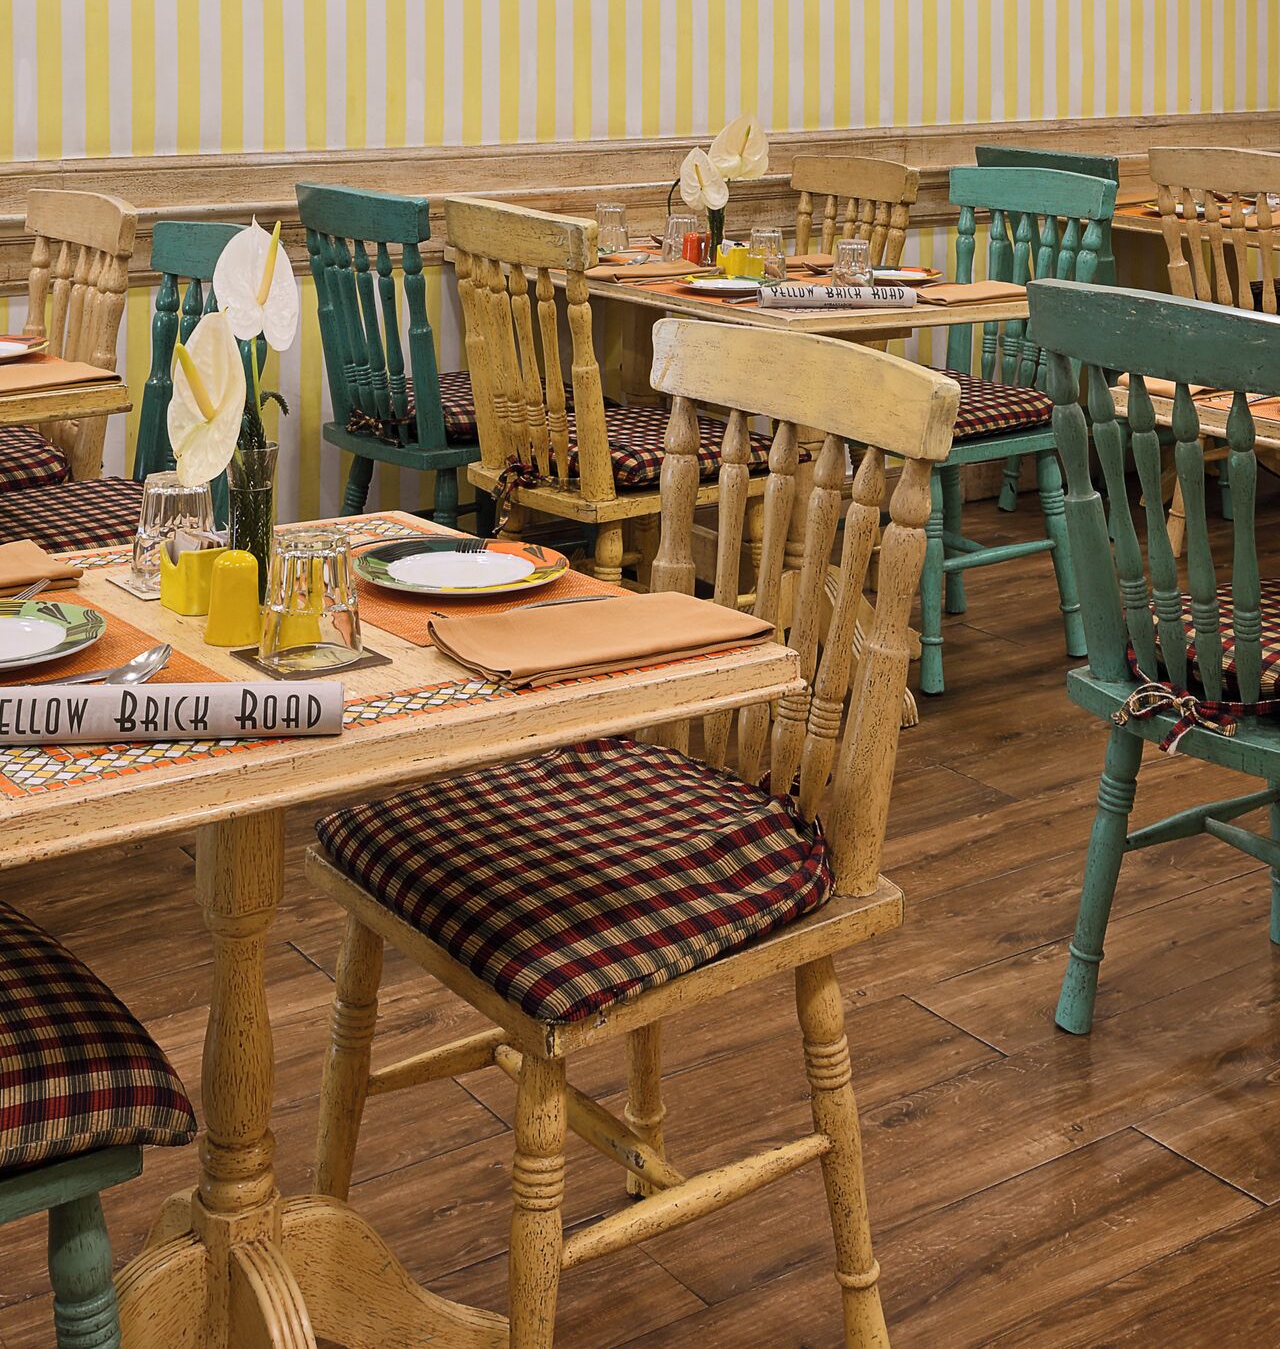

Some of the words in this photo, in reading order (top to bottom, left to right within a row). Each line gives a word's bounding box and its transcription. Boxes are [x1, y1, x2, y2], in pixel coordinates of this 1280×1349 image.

[770, 287, 815, 298] YELLOW
[825, 287, 862, 299] BRICK
[871, 287, 905, 300] ROAD
[114, 689, 210, 733] BRICK
[234, 688, 322, 731] ROAD
